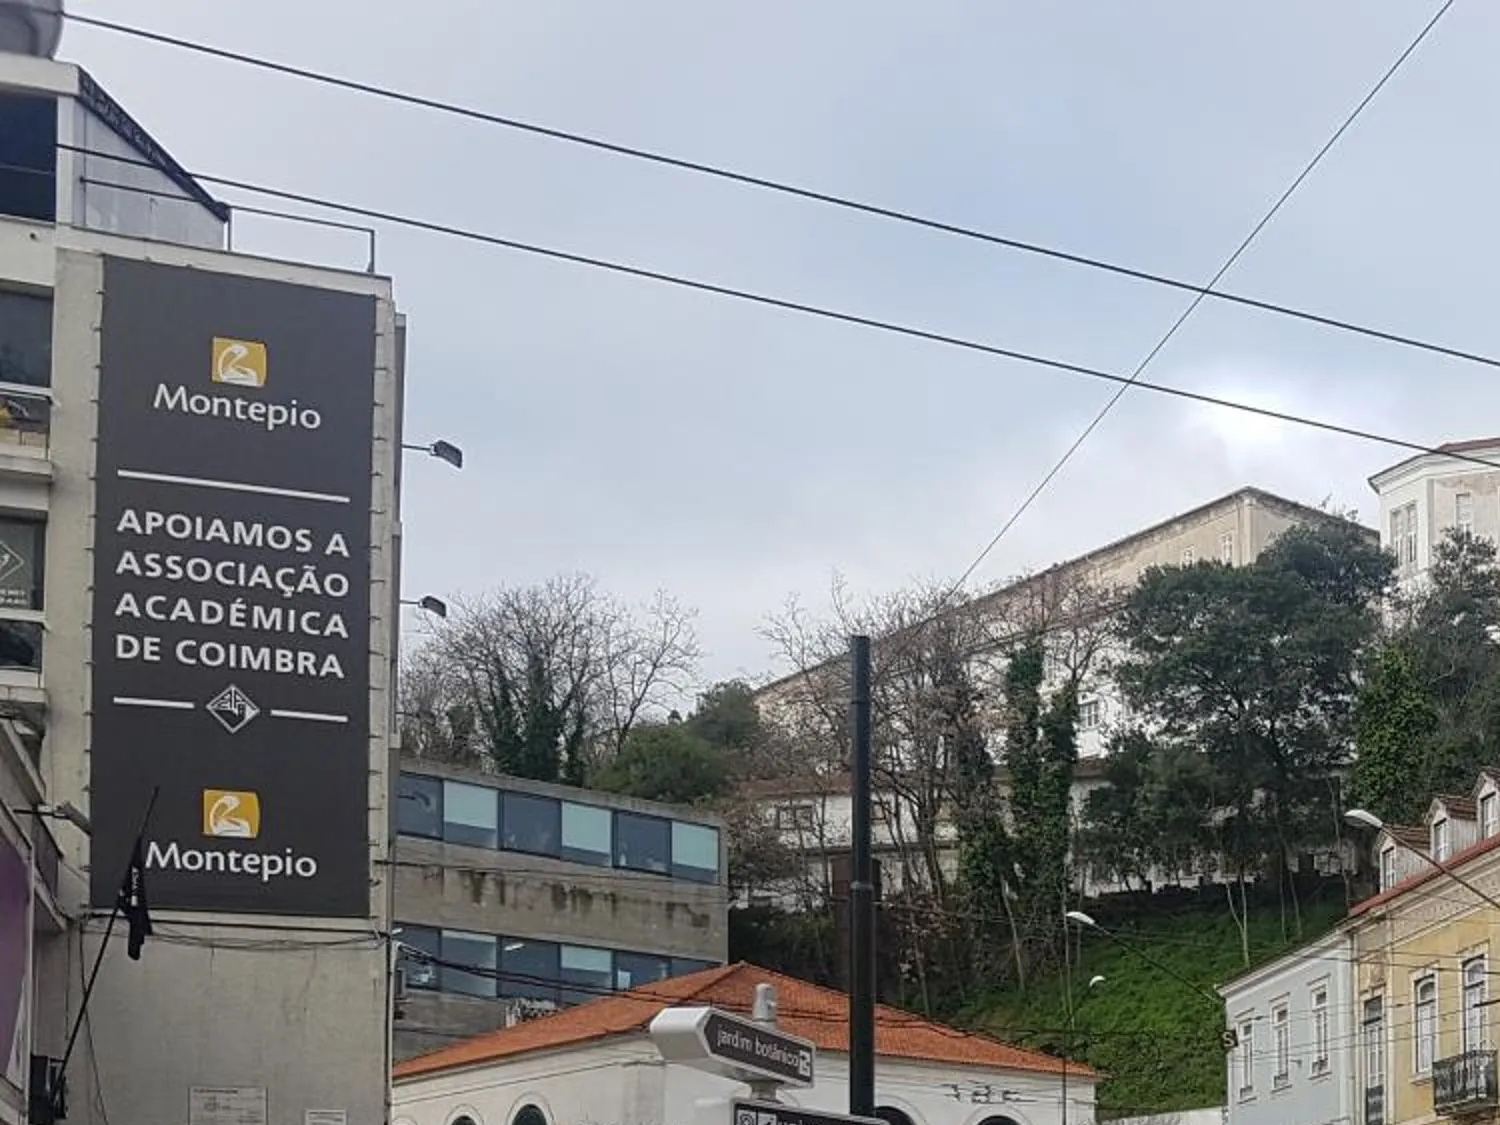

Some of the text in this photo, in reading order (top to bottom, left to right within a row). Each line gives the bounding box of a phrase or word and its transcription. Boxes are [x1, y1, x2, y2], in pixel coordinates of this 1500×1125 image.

[153, 383, 321, 431] Montepio
[116, 509, 350, 558] APOIAMOS A
[115, 550, 350, 598] ASSOCIAÇÃO
[114, 592, 349, 639] ACADÉMICA
[116, 633, 345, 679] DE COIMBRA
[145, 841, 317, 882] Montepio
[717, 1025, 799, 1067] jardim botânico
